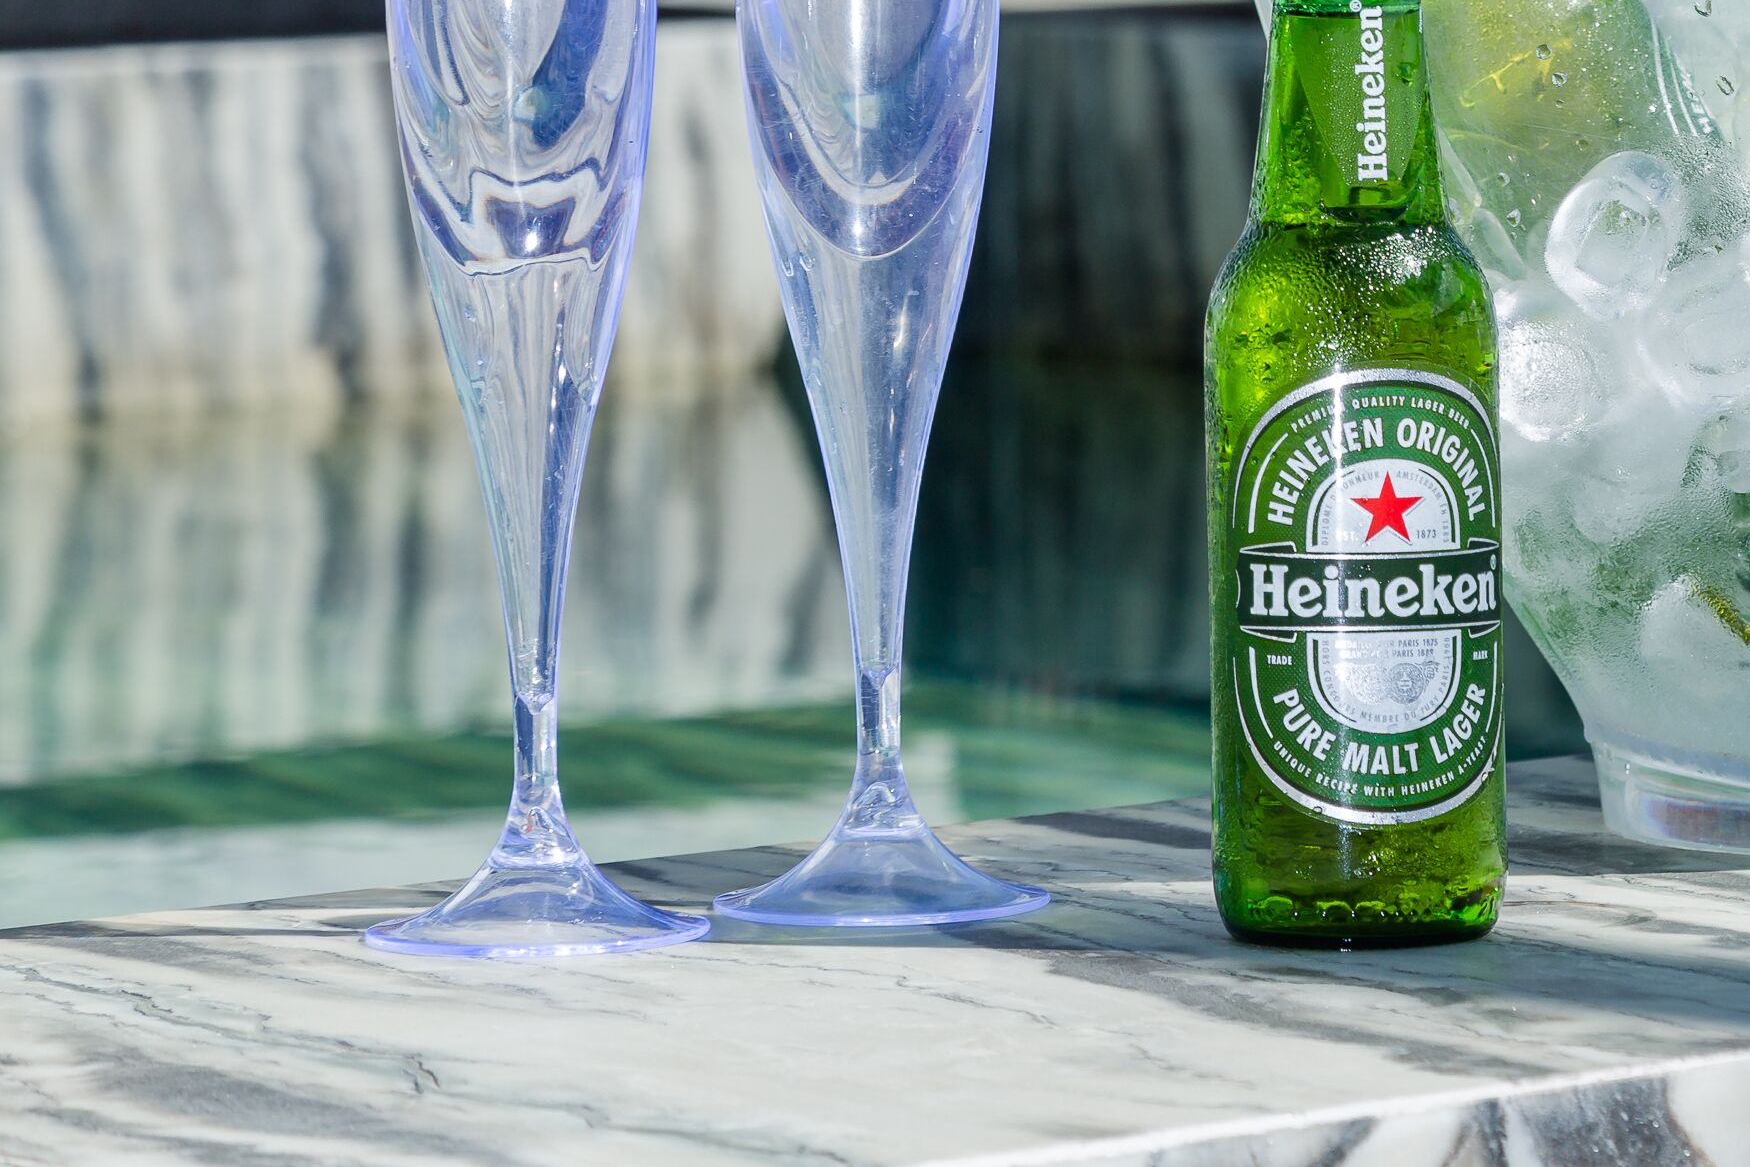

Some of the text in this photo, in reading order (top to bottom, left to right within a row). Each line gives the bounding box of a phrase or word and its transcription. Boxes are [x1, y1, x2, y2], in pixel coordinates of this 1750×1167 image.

[1355, 5, 1388, 182] Heineken
[1352, 395, 1407, 410] QUALITY
[1411, 396, 1445, 414] LAGER
[1448, 407, 1470, 430] BEER
[1267, 417, 1486, 526] HEINEKEN ORIGINAL
[1395, 470, 1444, 502] AMSTERDAM
[1416, 529, 1437, 539] 1873
[1249, 563, 1498, 618] Heineken
[1266, 654, 1293, 666] TRADE
[1392, 648, 1414, 658] PARIS
[1397, 638, 1420, 649] PARIS
[1321, 639, 1331, 665] HORS
[1360, 710, 1399, 723] MEMBRE
[1404, 712, 1418, 722] DU
[1420, 694, 1441, 715] JURY
[1440, 665, 1451, 694] PARIS
[1272, 682, 1487, 775] PURE MALT LAGER
[1273, 741, 1312, 778] UNIQUE
[1315, 771, 1359, 796] RECIPE
[1363, 784, 1396, 797] WITH
[1400, 770, 1455, 795] HEINEKEN
